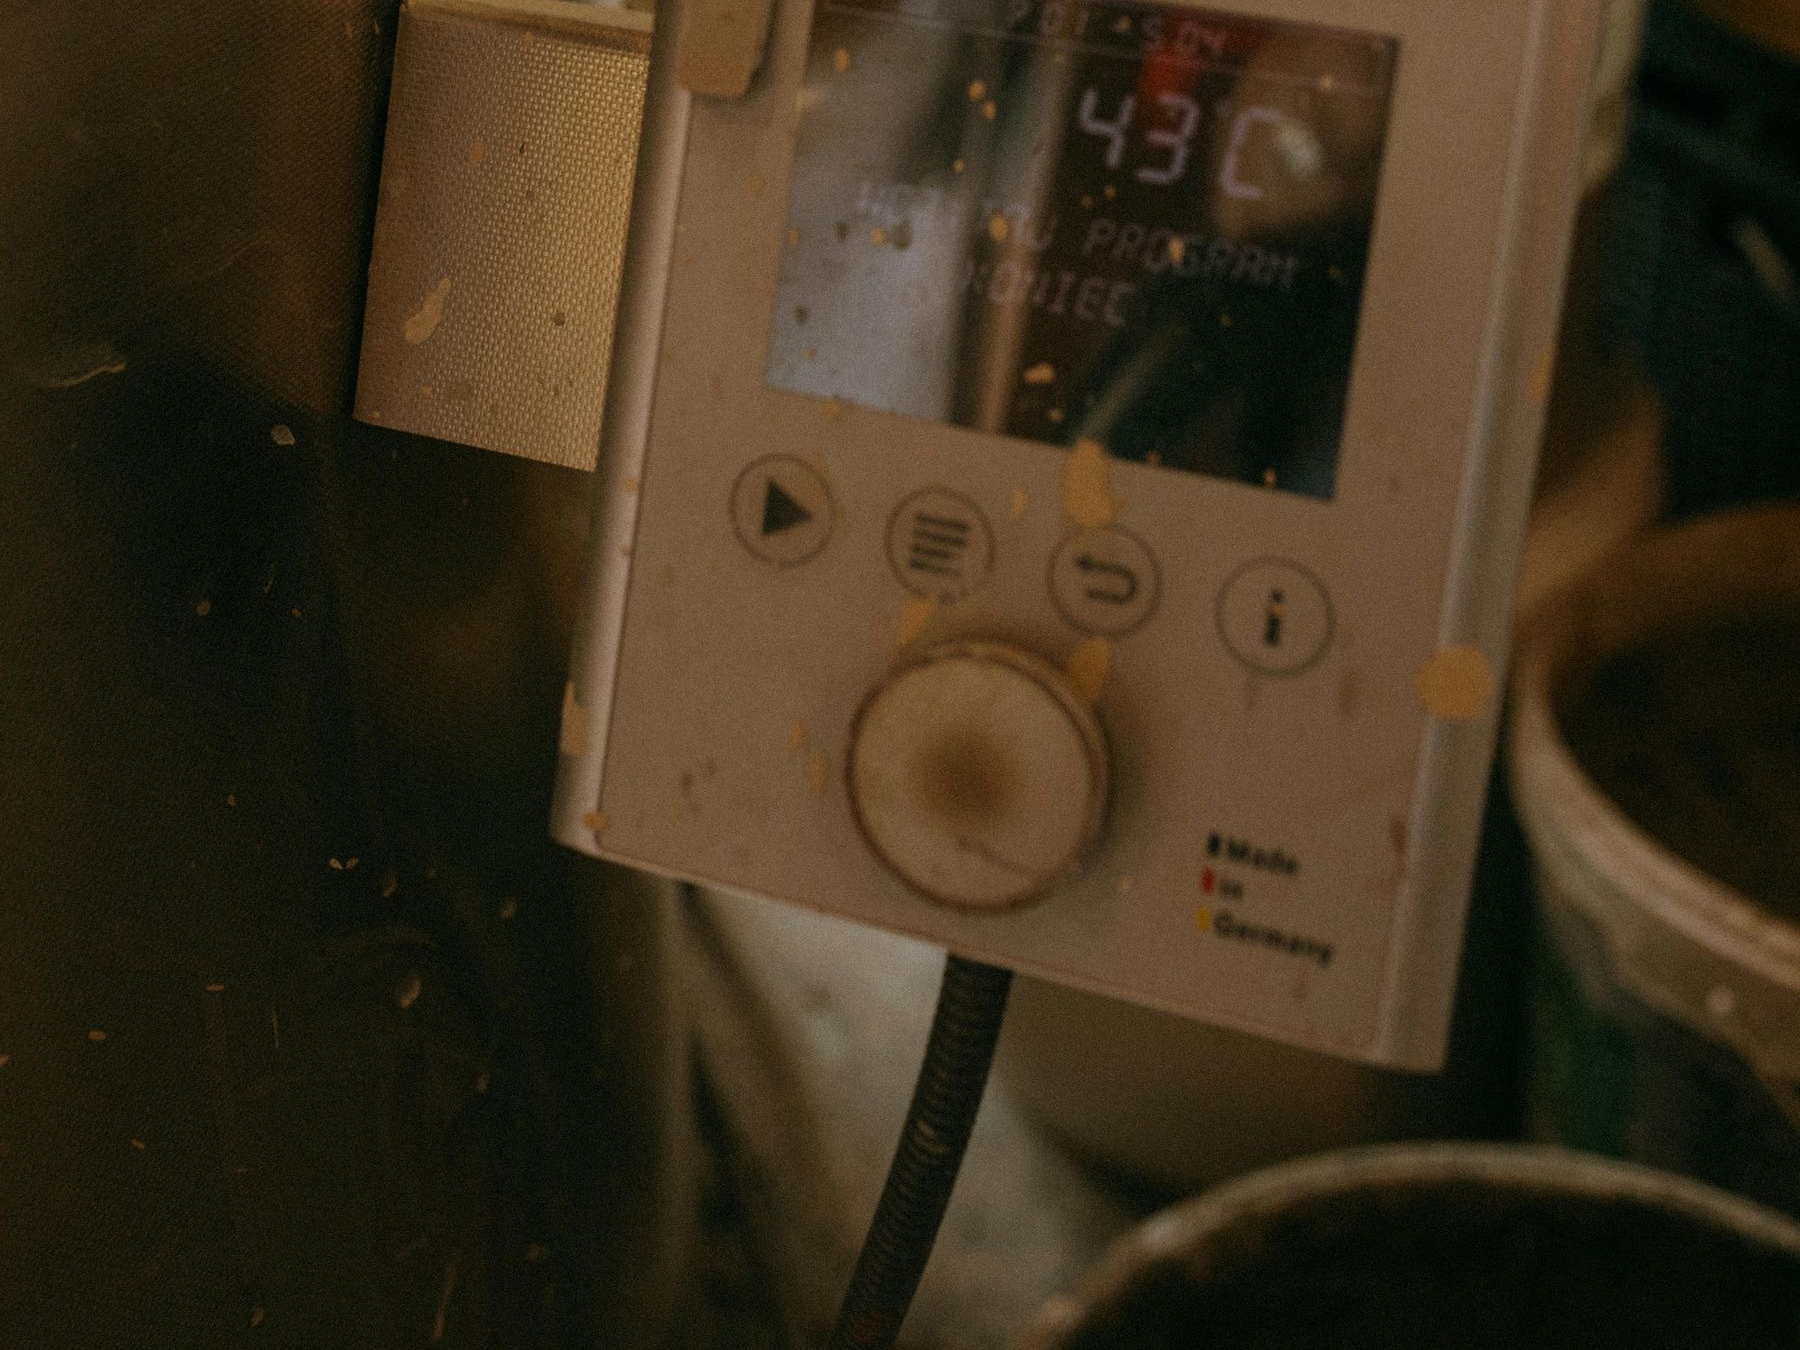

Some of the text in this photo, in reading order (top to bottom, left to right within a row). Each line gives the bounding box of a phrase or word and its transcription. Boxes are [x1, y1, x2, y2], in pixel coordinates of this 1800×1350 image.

[1079, 88, 1198, 183] 43
[1081, 216, 1302, 295] PROGRAM
[1227, 837, 1297, 875] Made
[1214, 910, 1333, 968] Germany
